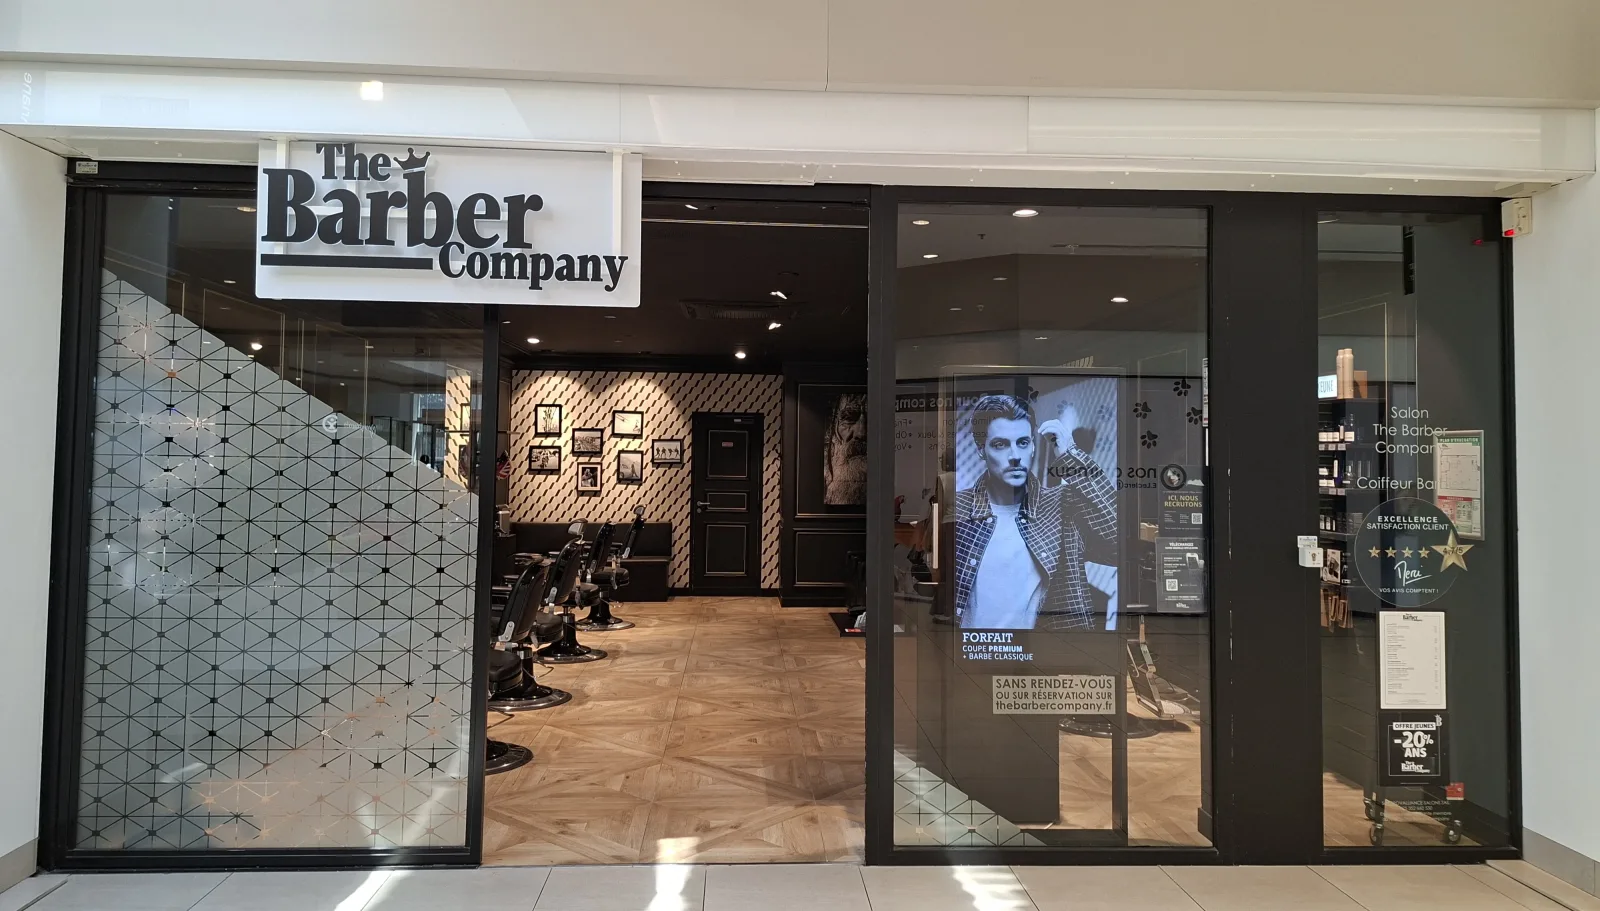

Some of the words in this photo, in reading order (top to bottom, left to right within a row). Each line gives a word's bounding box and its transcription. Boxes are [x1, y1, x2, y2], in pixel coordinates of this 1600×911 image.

[316, 143, 392, 181] The
[261, 168, 544, 249] Barber
[438, 242, 628, 292] Company
[1391, 406, 1429, 419] Salon
[1372, 423, 1398, 436] The
[1402, 424, 1448, 437] Barber
[1356, 476, 1413, 490] Coiffeur
[1377, 515, 1438, 523] EXCELLENCE
[1366, 522, 1421, 530] SATISFACTION
[1422, 523, 1449, 531] CLIENT
[962, 632, 1014, 643] FORFAIT
[988, 645, 1023, 653] PREMIUM
[968, 652, 992, 660] BARBE
[994, 653, 1034, 662] CLASSIQUE
[995, 678, 1027, 689] SANS
[1030, 678, 1113, 689] RENDEZ-VOUS
[995, 691, 1010, 700] OU
[1012, 691, 1029, 700] SUR
[1032, 689, 1093, 700] RÉSERVATION
[1096, 691, 1113, 700] SUR
[995, 701, 1113, 712] thebarbercompany.fr
[1393, 731, 1434, 748] -20%
[1404, 747, 1427, 758] ANS
